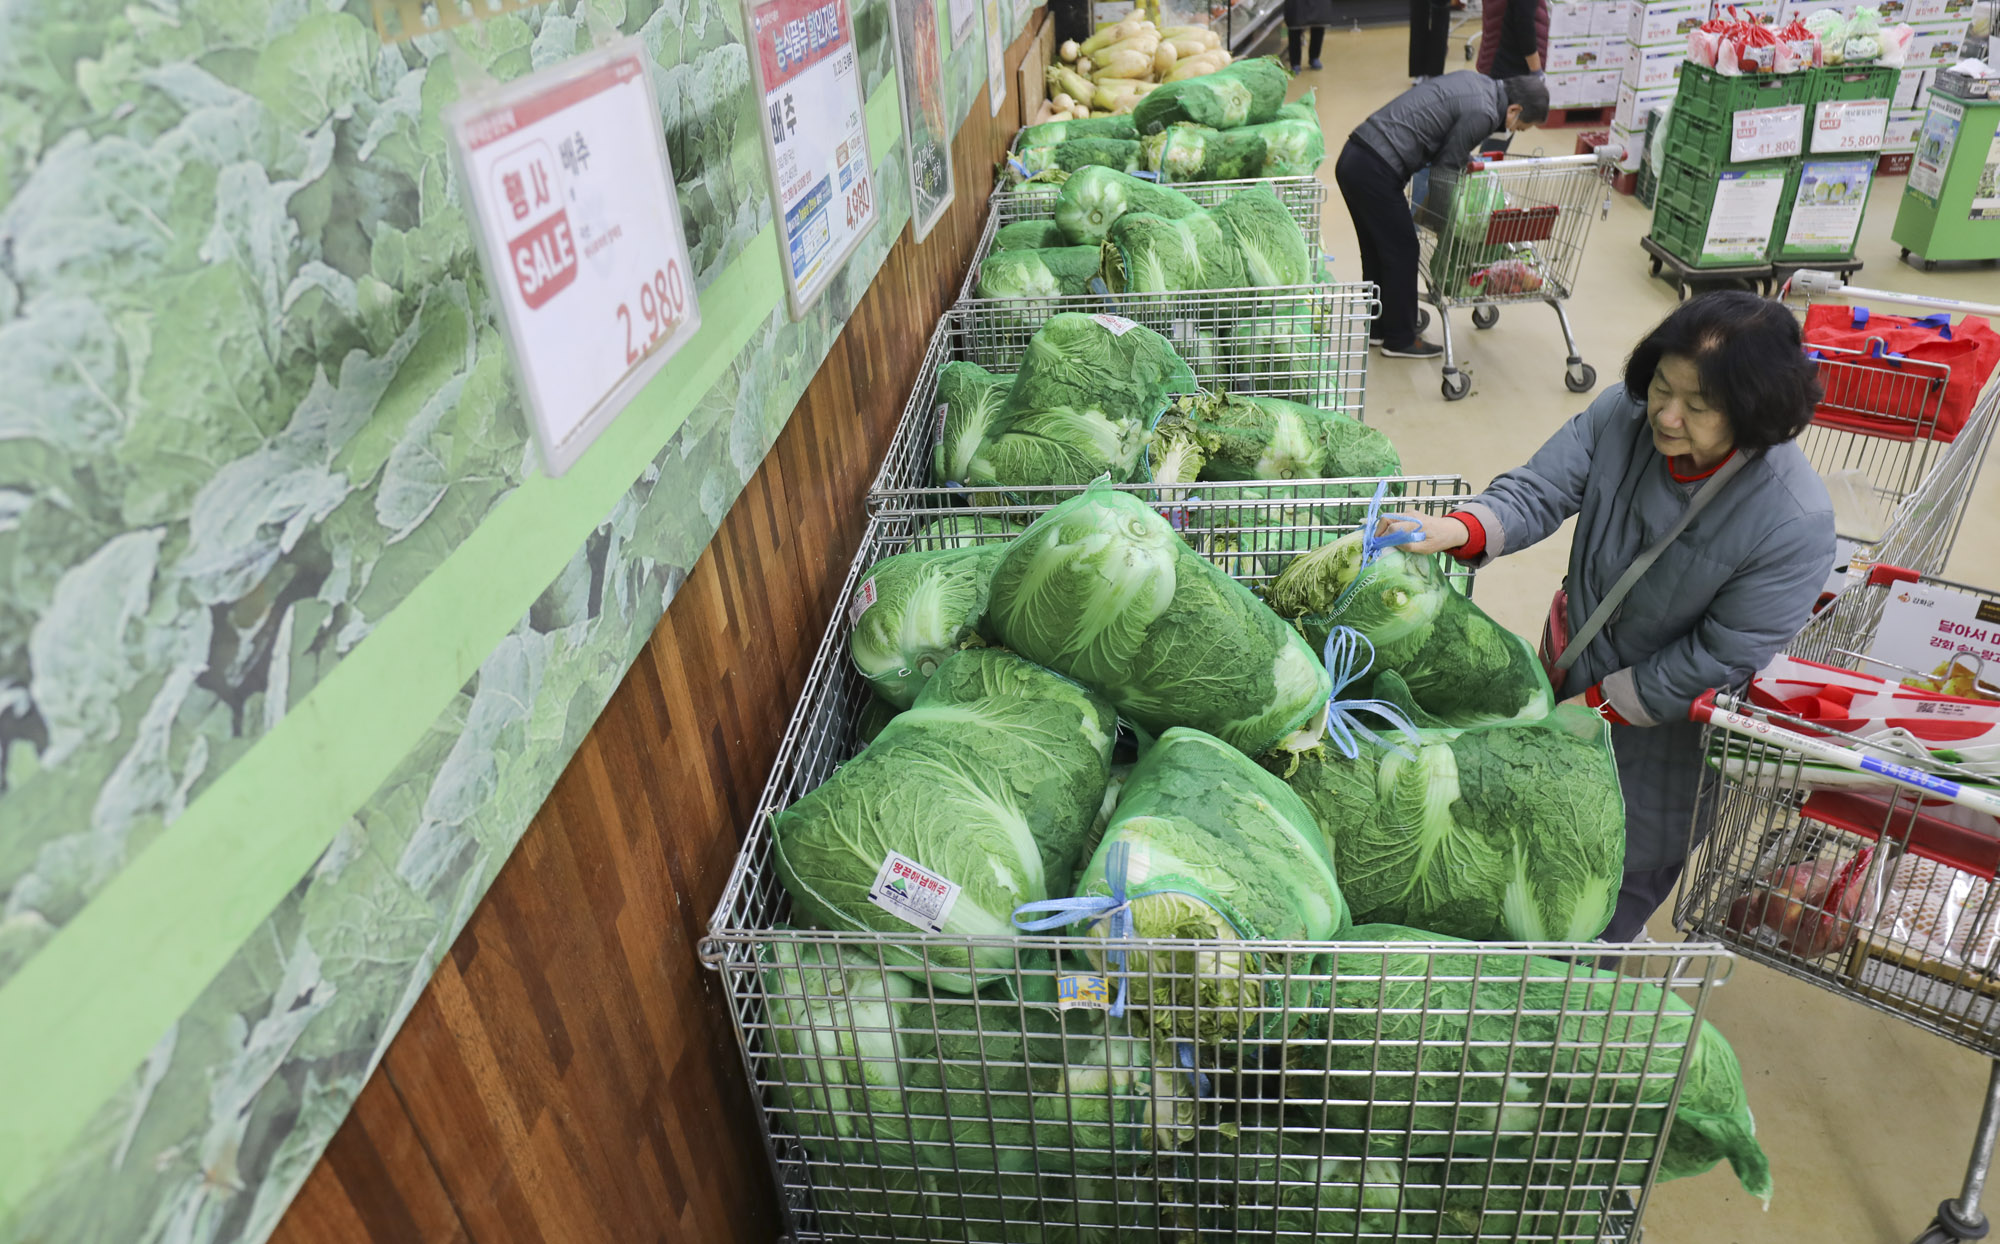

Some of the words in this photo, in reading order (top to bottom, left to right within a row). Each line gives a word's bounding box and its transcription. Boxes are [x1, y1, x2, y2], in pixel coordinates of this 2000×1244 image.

[773, 16, 809, 71] 농식품부
[807, 1, 840, 50] 할인지원
[769, 92, 797, 145] 배추
[558, 131, 591, 175] 배추
[1758, 140, 1796, 154] 41,800
[1840, 136, 1880, 148] 25,800
[503, 158, 550, 221] 행사
[846, 177, 869, 230] 4,980
[517, 221, 576, 295] SALE
[617, 257, 684, 366] 2,980
[1912, 597, 1935, 609] 강화군
[1930, 636, 1955, 651] 강화
[1938, 619, 1987, 642] 달아서
[1058, 976, 1107, 1001] 파주
